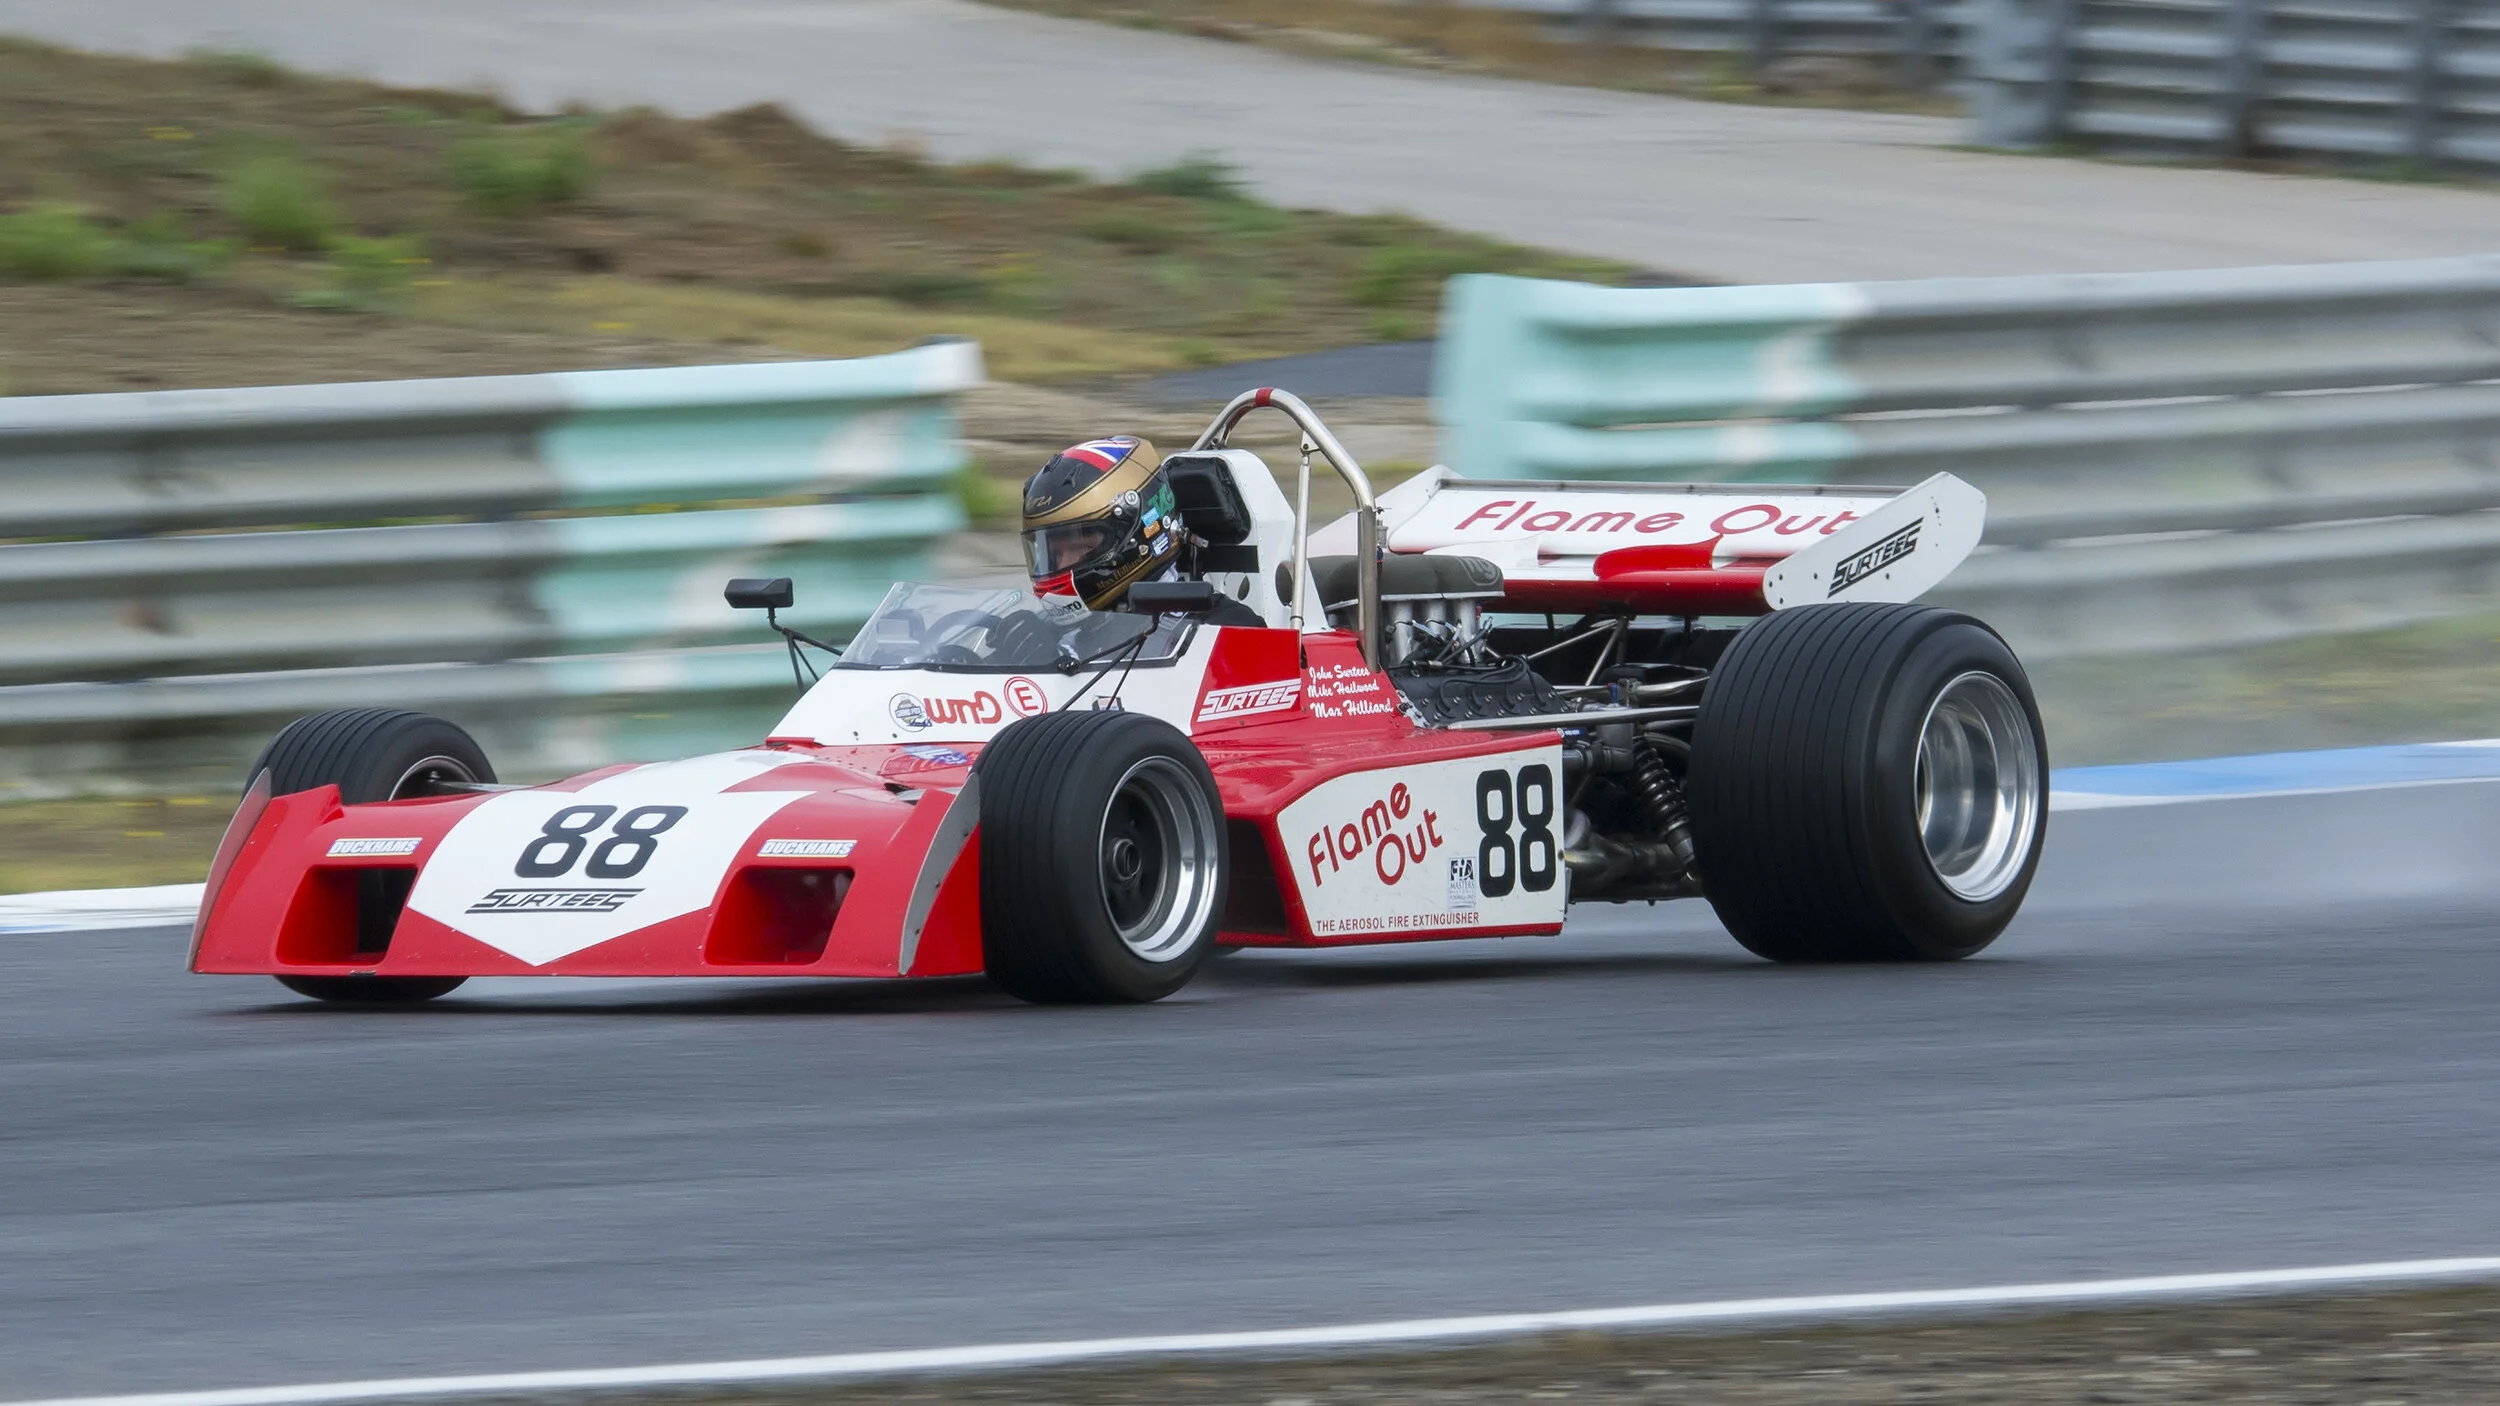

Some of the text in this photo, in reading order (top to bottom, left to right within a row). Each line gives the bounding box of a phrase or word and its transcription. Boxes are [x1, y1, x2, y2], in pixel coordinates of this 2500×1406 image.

[1455, 501, 1861, 535] Flame Out
[1828, 522, 1922, 593] SURTEES
[1309, 664, 1371, 684] John Surtees
[1014, 687, 1039, 712] E
[1199, 681, 1300, 718] SURTEES
[1308, 679, 1379, 699] Mike Hailwood
[1310, 698, 1394, 719] Max Hilliard
[514, 805, 689, 878] 88
[1308, 782, 1411, 888] Flame
[1476, 763, 1556, 898] 88
[328, 840, 420, 854] DUCKHAMS
[759, 841, 855, 855] DUCKHAMS
[1376, 808, 1443, 886] Out
[467, 888, 643, 914] SURTEES
[1316, 911, 1479, 932] THE AEROSOL FIRE EXTINGUISHER
